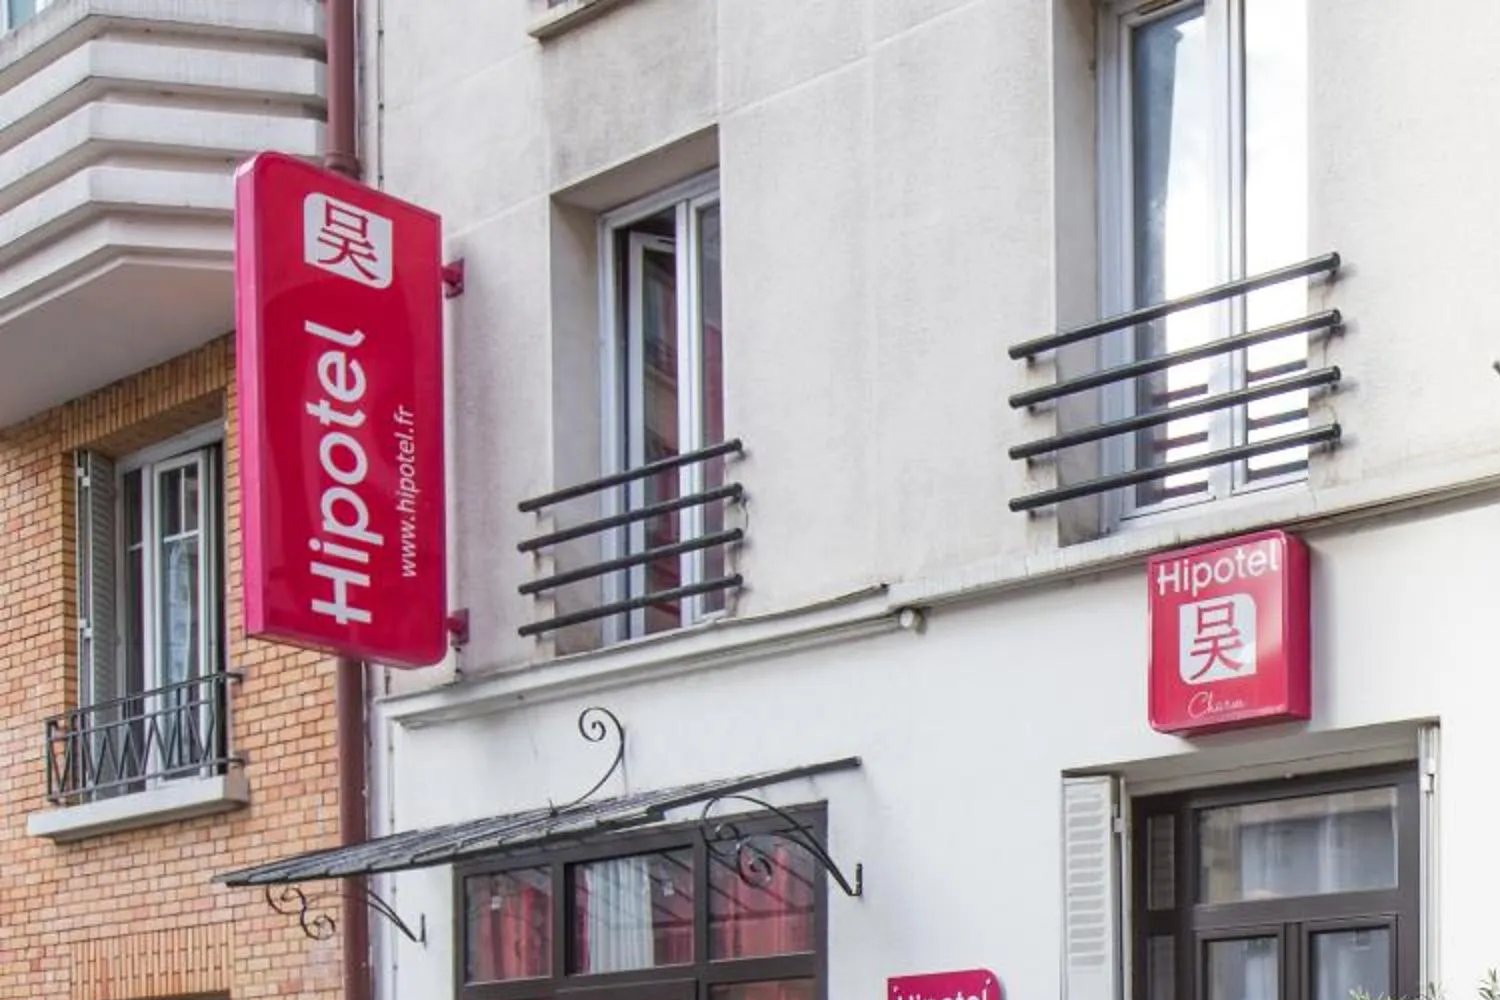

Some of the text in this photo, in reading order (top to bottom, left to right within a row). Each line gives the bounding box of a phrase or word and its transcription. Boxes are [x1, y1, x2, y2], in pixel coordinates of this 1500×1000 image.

[304, 320, 384, 625] Hipotel
[393, 404, 418, 578] www.hipotel.fr
[1157, 540, 1280, 597] Hipotel
